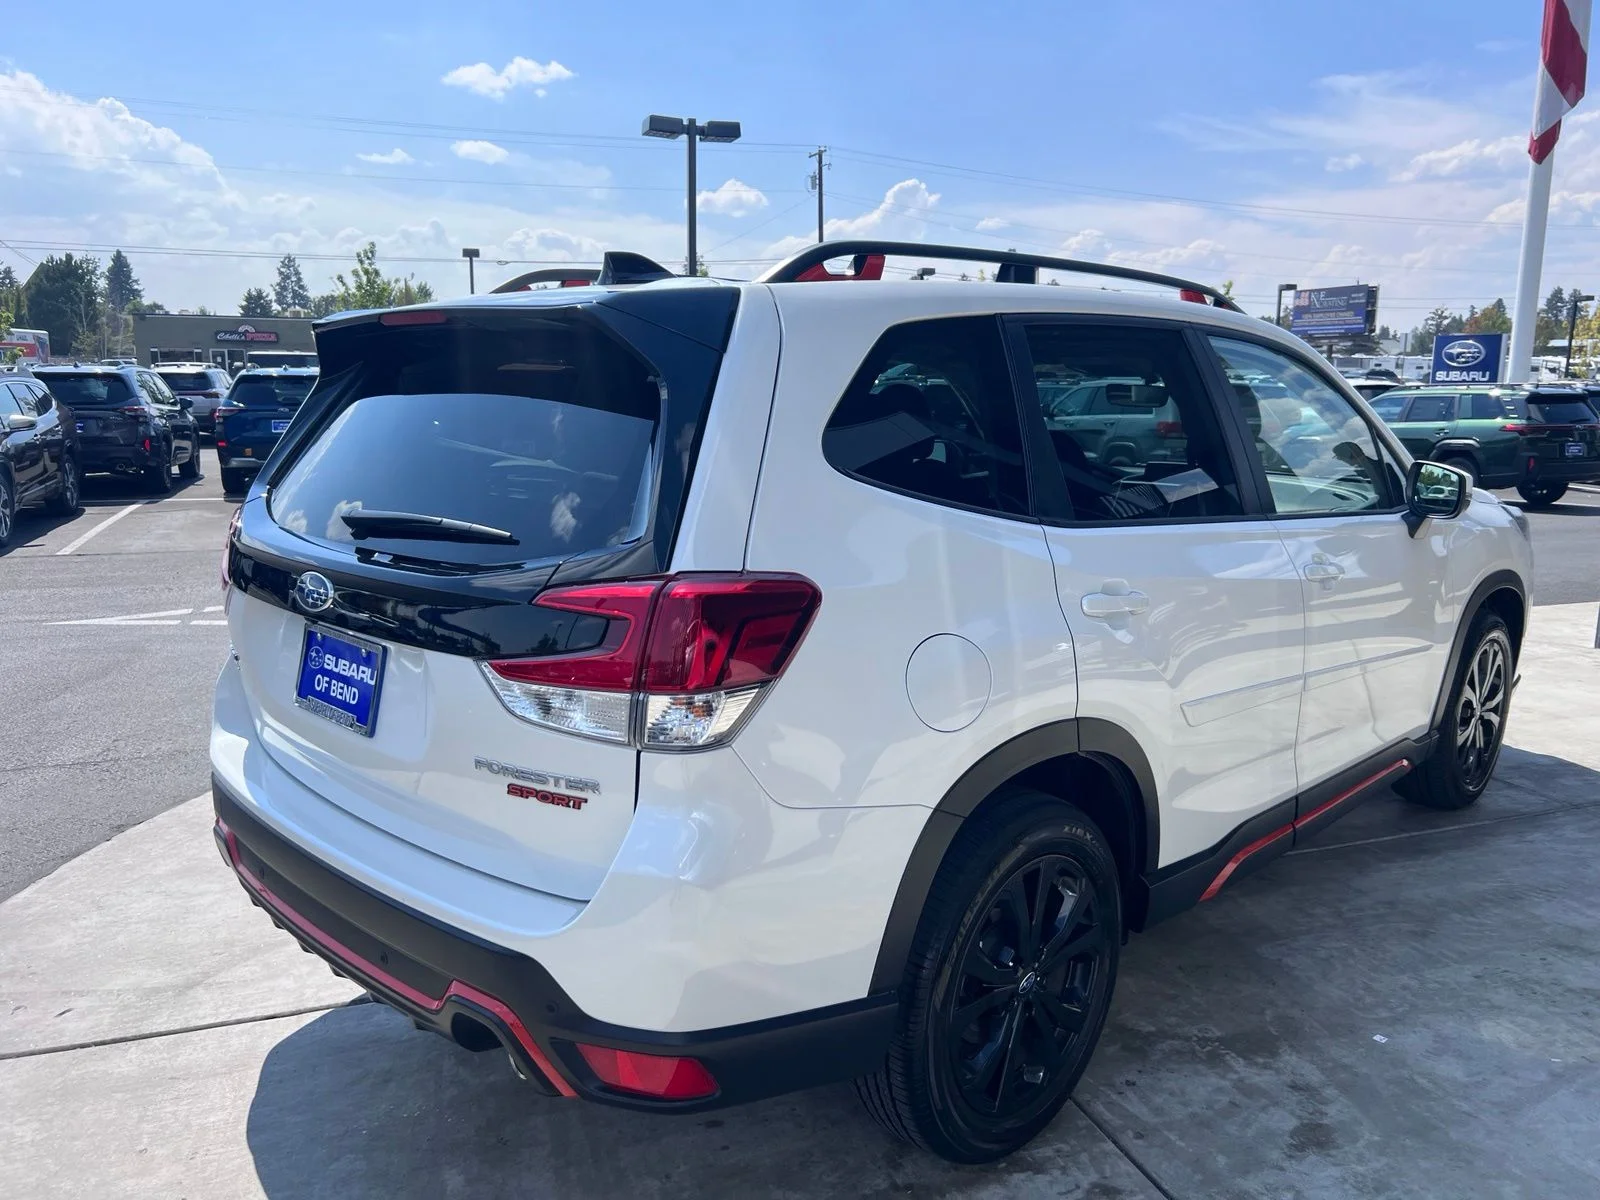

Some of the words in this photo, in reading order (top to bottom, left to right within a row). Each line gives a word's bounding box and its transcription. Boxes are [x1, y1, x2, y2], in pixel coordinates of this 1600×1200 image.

[1435, 370, 1490, 381] SUBARU
[323, 653, 377, 685] SUBARU
[314, 674, 330, 693] OF
[330, 679, 358, 705] BEND
[474, 755, 602, 796] FORESTER
[507, 783, 588, 810] SPORT
